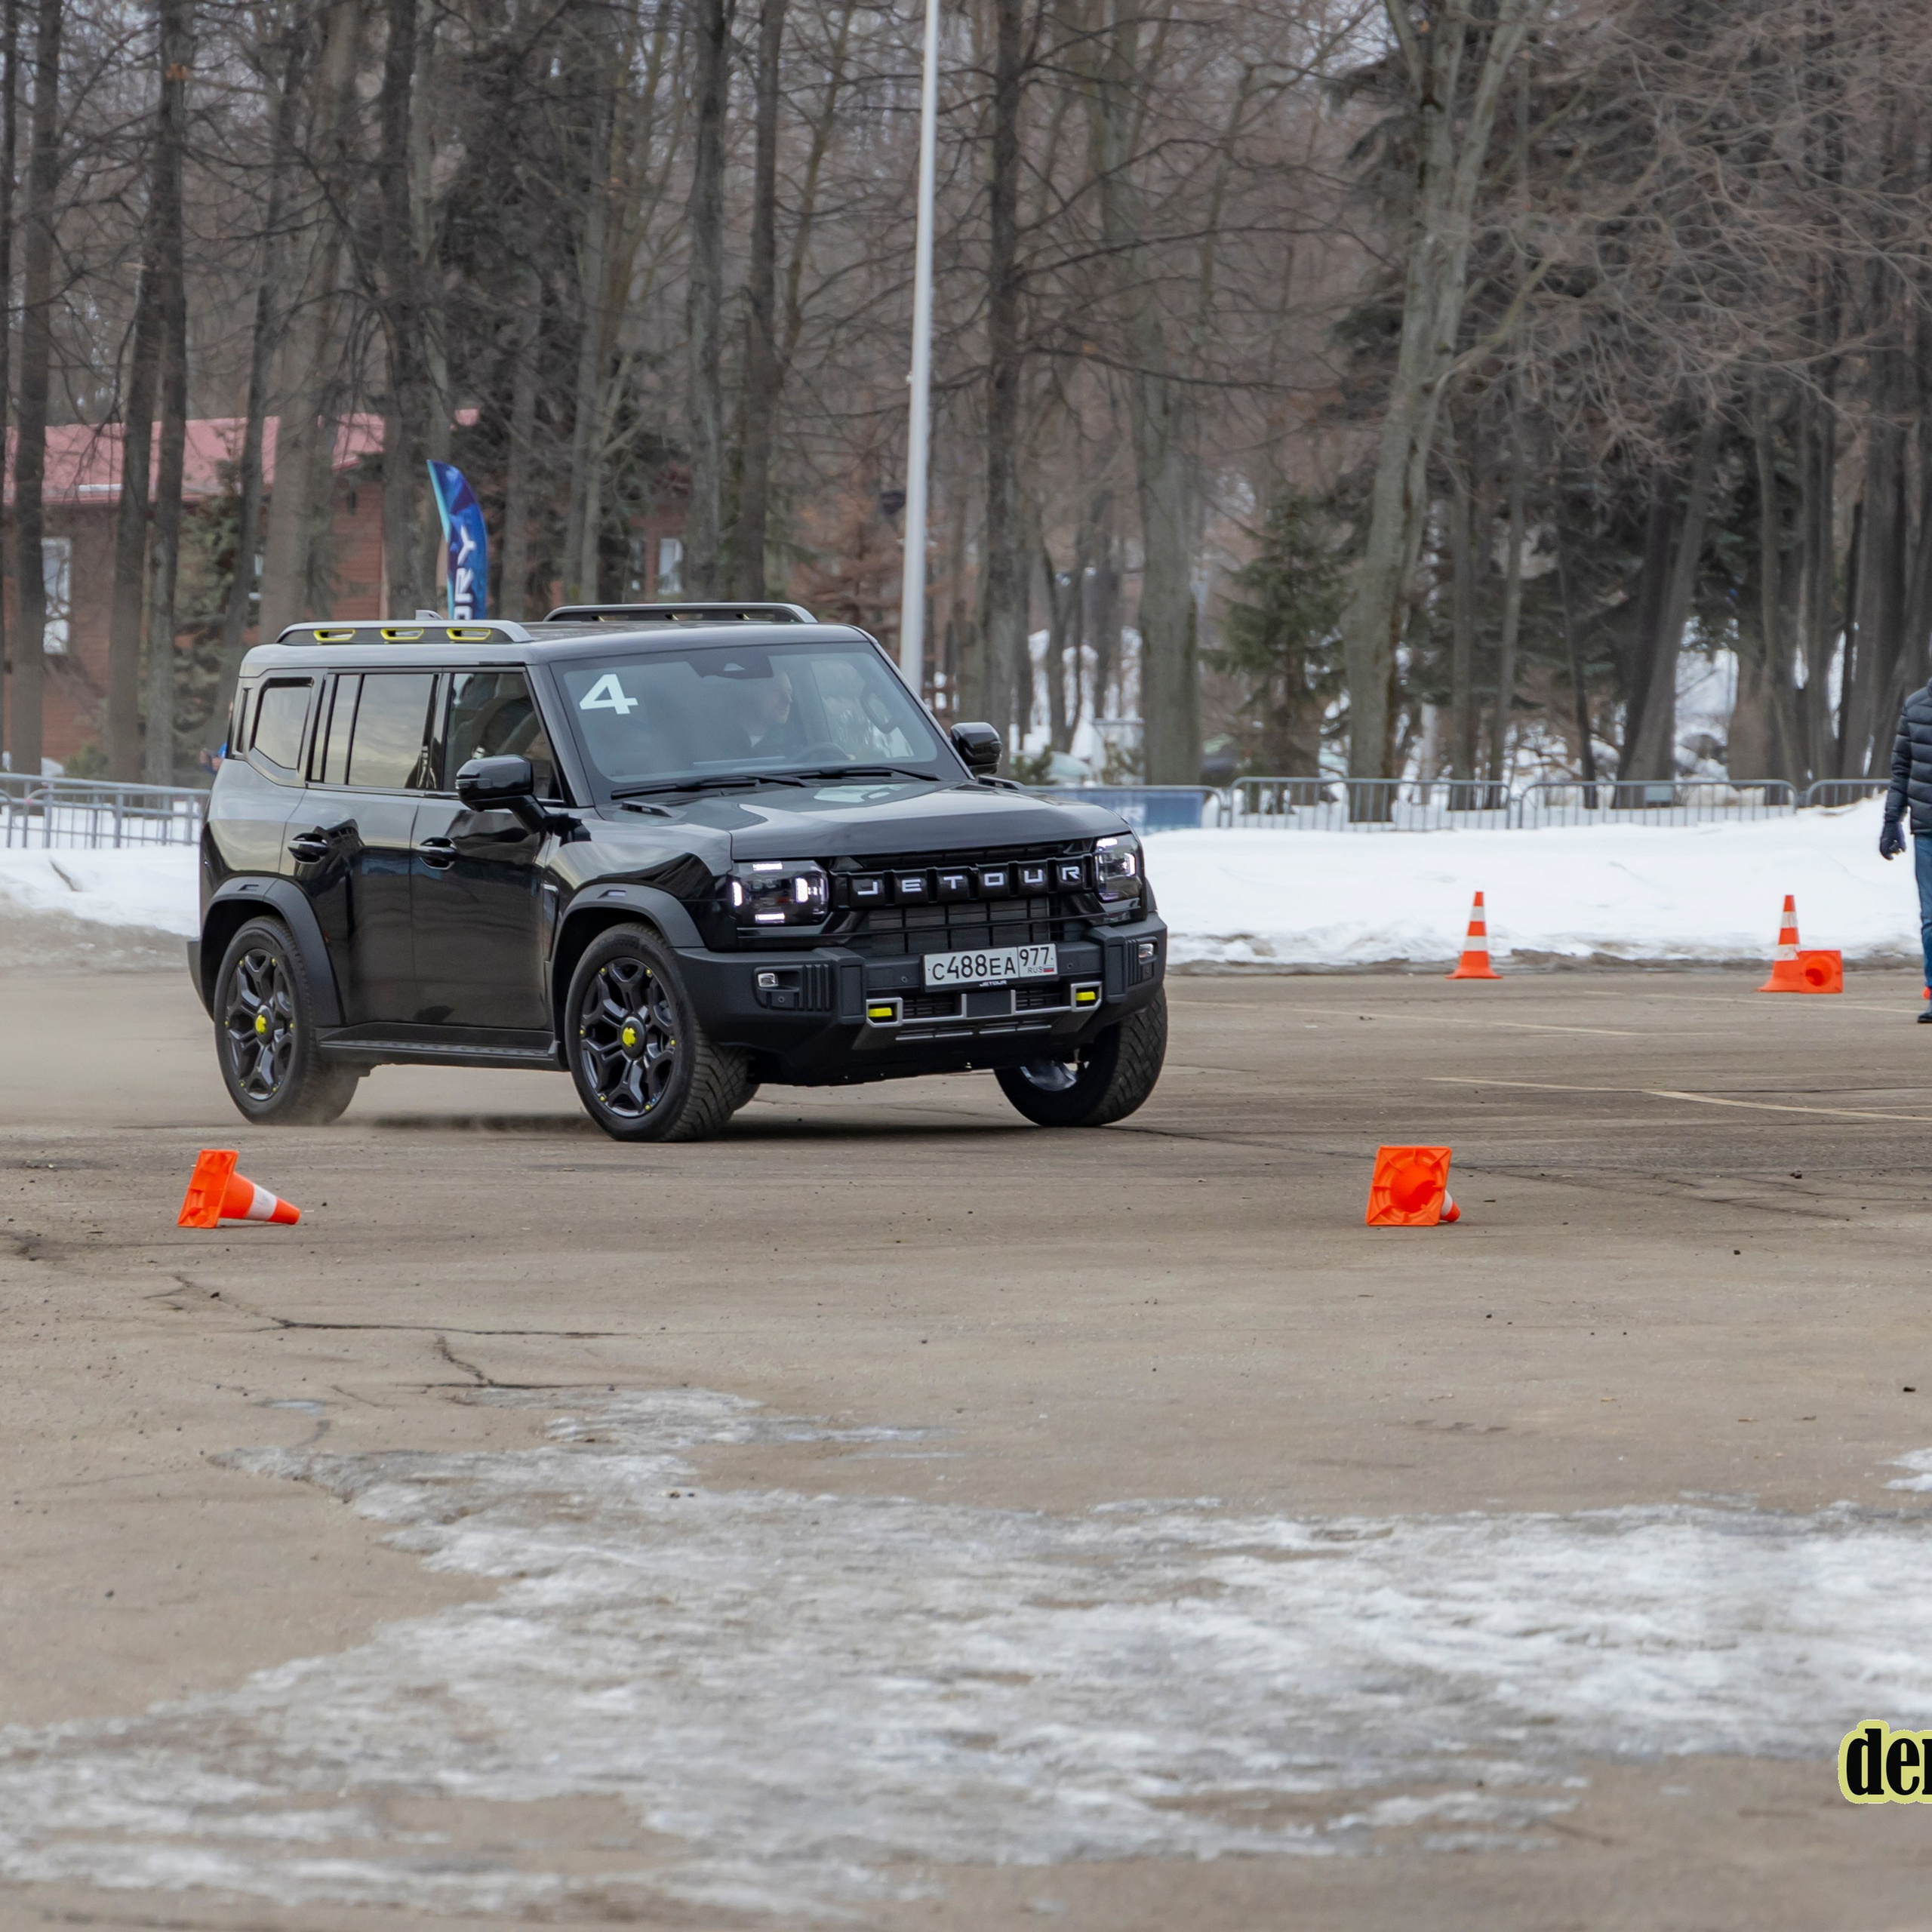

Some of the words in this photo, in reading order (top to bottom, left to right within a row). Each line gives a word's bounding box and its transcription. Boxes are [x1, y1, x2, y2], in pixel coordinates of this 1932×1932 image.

[579, 674, 638, 715] 4
[857, 866, 1079, 896] JETOUR
[1020, 947, 1049, 967] 977
[1027, 964, 1043, 974] RUS
